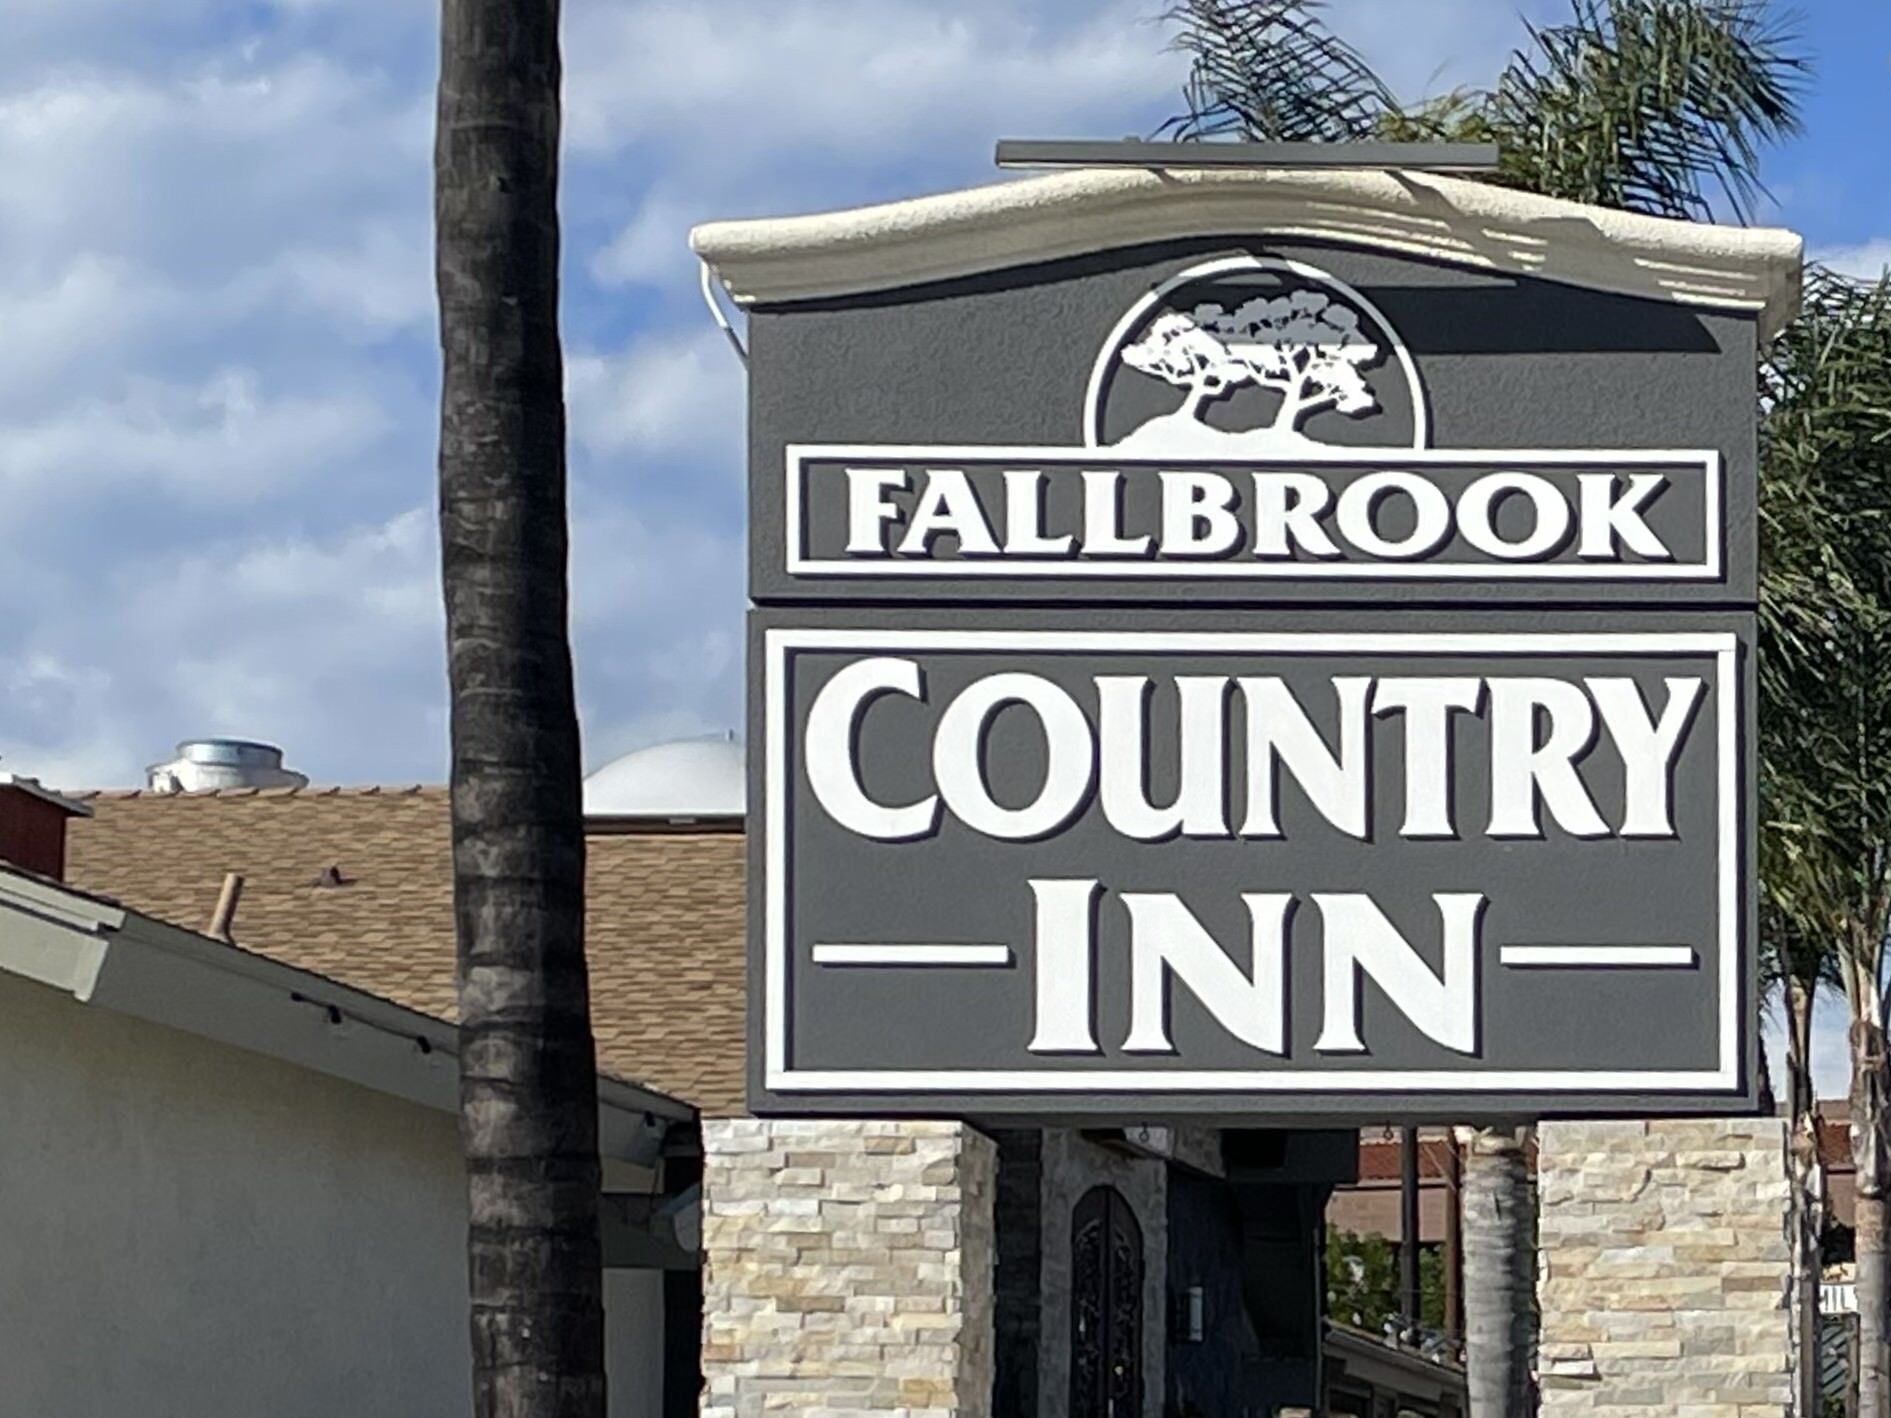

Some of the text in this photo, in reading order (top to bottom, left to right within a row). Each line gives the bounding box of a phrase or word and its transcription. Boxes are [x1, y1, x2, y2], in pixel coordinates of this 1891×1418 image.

[844, 467, 1672, 560] FALLBROOK
[804, 655, 1707, 843] COUNTRY
[1026, 877, 1489, 1058] INN
